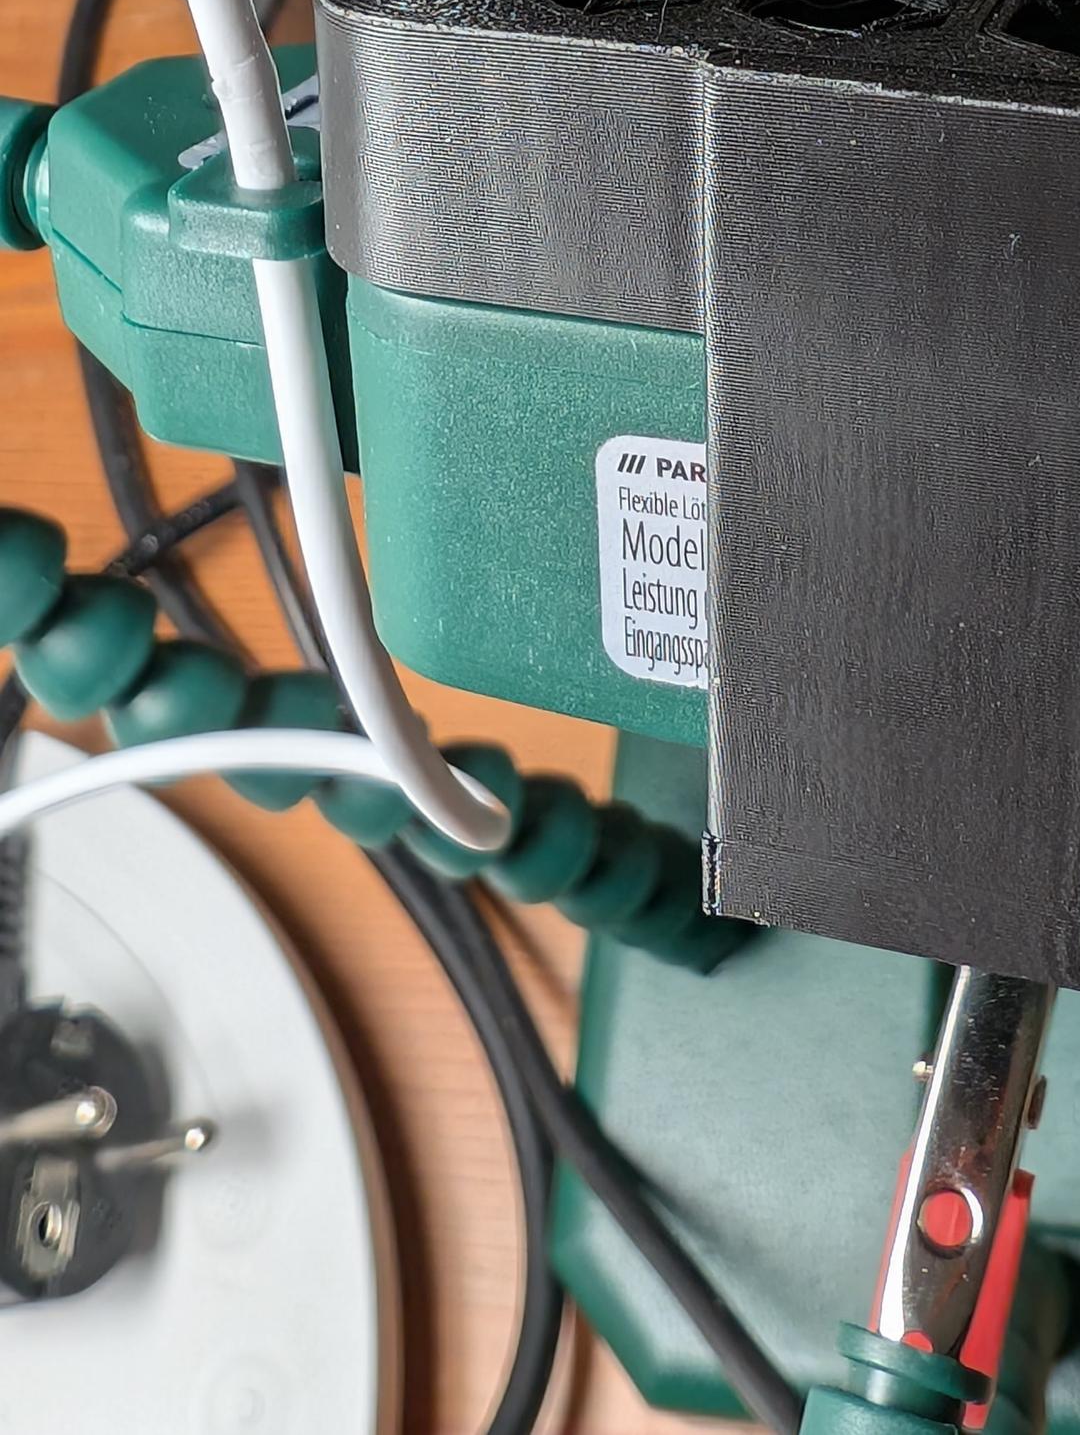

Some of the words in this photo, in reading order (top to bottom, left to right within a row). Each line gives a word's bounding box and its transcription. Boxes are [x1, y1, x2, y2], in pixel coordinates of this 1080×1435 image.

[619, 486, 679, 518] Flexible
[622, 517, 705, 571] Model
[623, 567, 699, 630] Leistung
